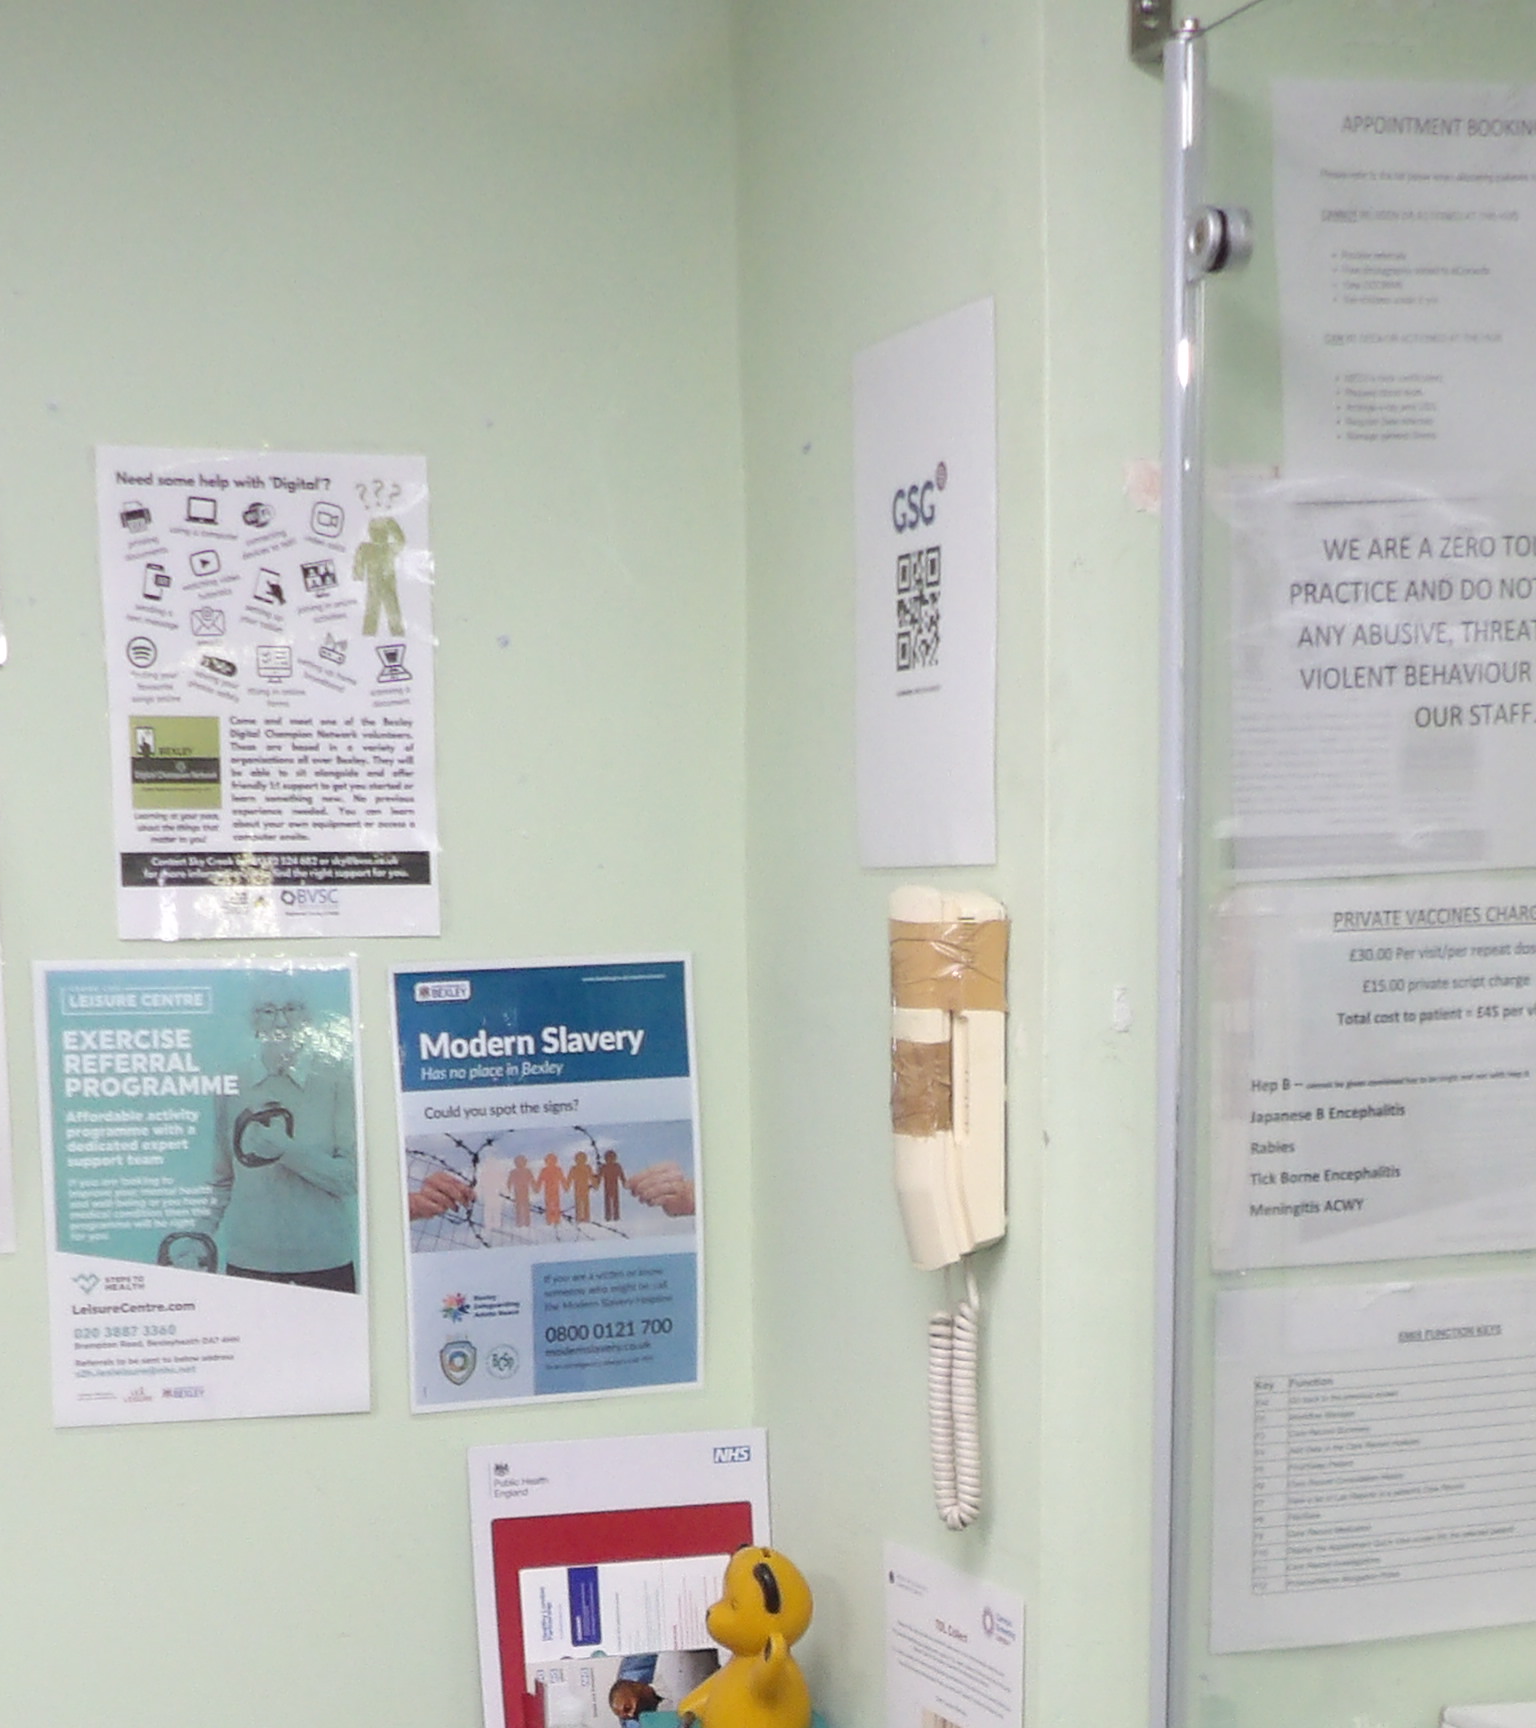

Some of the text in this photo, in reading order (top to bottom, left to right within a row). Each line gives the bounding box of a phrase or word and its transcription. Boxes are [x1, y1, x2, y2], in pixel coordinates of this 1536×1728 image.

[1341, 116, 1462, 135] APPOINTMENT
[116, 473, 153, 486] Need
[158, 476, 194, 488] some
[200, 476, 228, 490] help
[234, 476, 264, 488] with
[893, 481, 935, 533] GSG
[1323, 537, 1360, 561] WE
[1368, 536, 1411, 560] ARE
[1418, 537, 1432, 558] A
[1439, 535, 1495, 559] ZERO
[1290, 580, 1398, 605] PRACTICE
[1405, 578, 1453, 603] AND
[1460, 578, 1493, 601] DO
[1297, 624, 1345, 648] ANY
[1352, 621, 1454, 648] ABUSIVE,
[1300, 667, 1397, 690] VIOLENT
[1405, 661, 1532, 687] BEHAVIOUR
[1414, 705, 1464, 729] OUR
[230, 730, 260, 739] Digital
[266, 730, 312, 740] Champion
[318, 730, 356, 739] Network
[297, 889, 338, 904] BVSC
[1333, 910, 1401, 930] PRIVATE
[1405, 907, 1482, 927] VACCINES
[69, 993, 204, 1008] LEISURE CENTRE
[432, 987, 466, 998] BEXLEY
[63, 1029, 192, 1050] EXERCISE
[420, 1025, 644, 1060] Modern Slavery
[64, 1053, 200, 1074] REFERRAL
[421, 1061, 564, 1081] Has no place in Bexley
[65, 1075, 240, 1097] PROGRAMME
[66, 1109, 200, 1123] Affordable activity
[424, 1099, 579, 1119] Could you spot the signs?
[1250, 1102, 1405, 1125] Japanese B Encephalitis
[66, 1125, 196, 1140] programme with a
[1250, 1139, 1295, 1156] Rabies
[1250, 1198, 1364, 1219] Meningitis ACWY
[104, 1283, 145, 1291] HEALTH
[72, 1302, 195, 1316] LeisureCentre.com
[74, 1328, 100, 1339] 020
[545, 1318, 673, 1343] 0800 0121 700
[714, 1446, 751, 1463] NHS
[494, 1476, 549, 1487] Public Health
[494, 1488, 528, 1498] England
